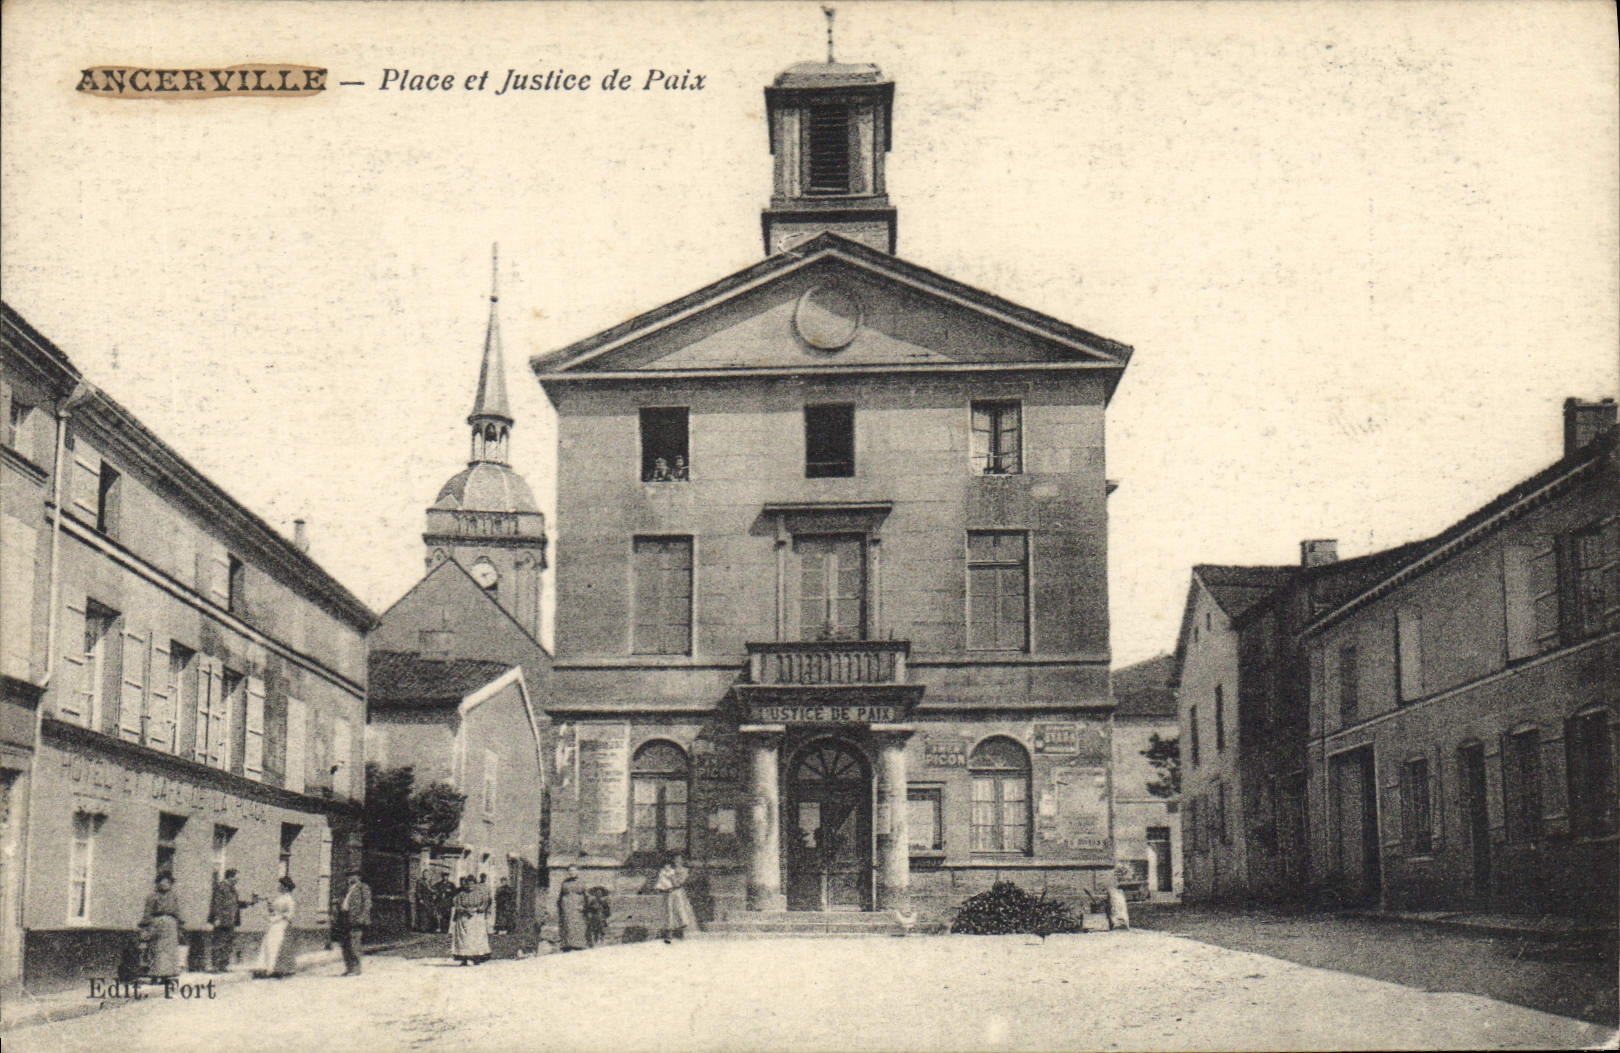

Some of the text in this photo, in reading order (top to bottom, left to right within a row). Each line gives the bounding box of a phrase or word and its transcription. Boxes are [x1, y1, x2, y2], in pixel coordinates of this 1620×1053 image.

[832, 706, 850, 721] DE
[858, 706, 892, 721] PAIX
[926, 753, 966, 766] PICON
